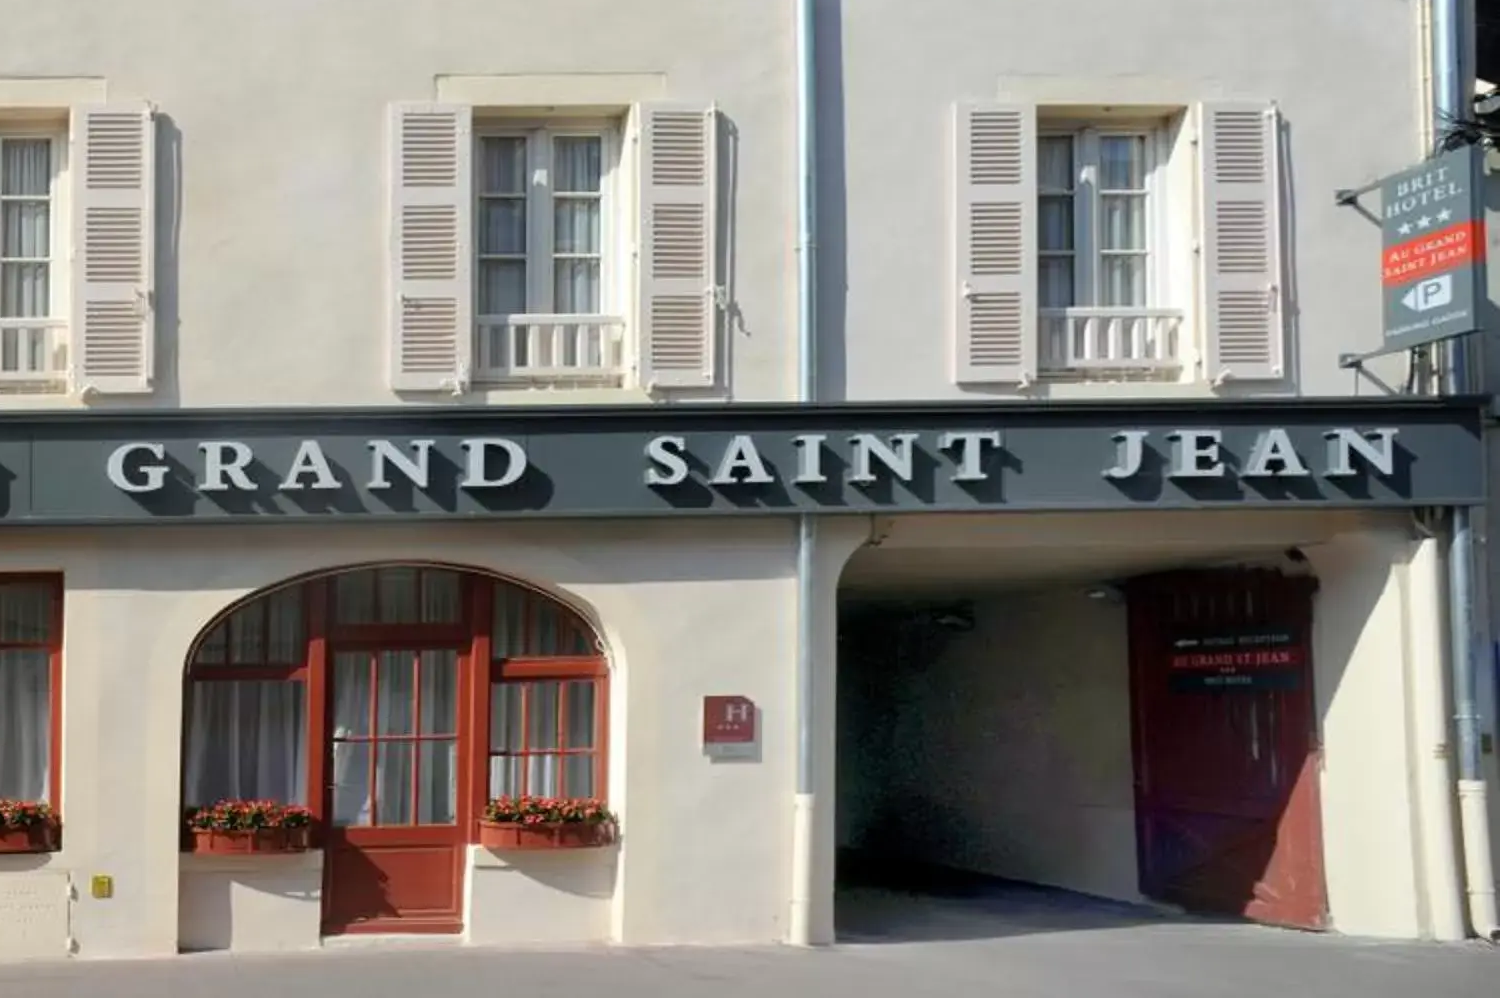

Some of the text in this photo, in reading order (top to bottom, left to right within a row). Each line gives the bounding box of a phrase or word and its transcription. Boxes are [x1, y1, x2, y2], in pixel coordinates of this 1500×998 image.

[1397, 166, 1449, 197] BRIT
[1386, 182, 1463, 219] HOTEL
[1413, 231, 1467, 255] GRAND
[1431, 245, 1468, 267] JEAN
[1422, 283, 1442, 305] P
[106, 439, 528, 493] GRAND
[643, 429, 1003, 486] SAINT
[1102, 427, 1400, 479] JEAN
[725, 703, 747, 722] H
